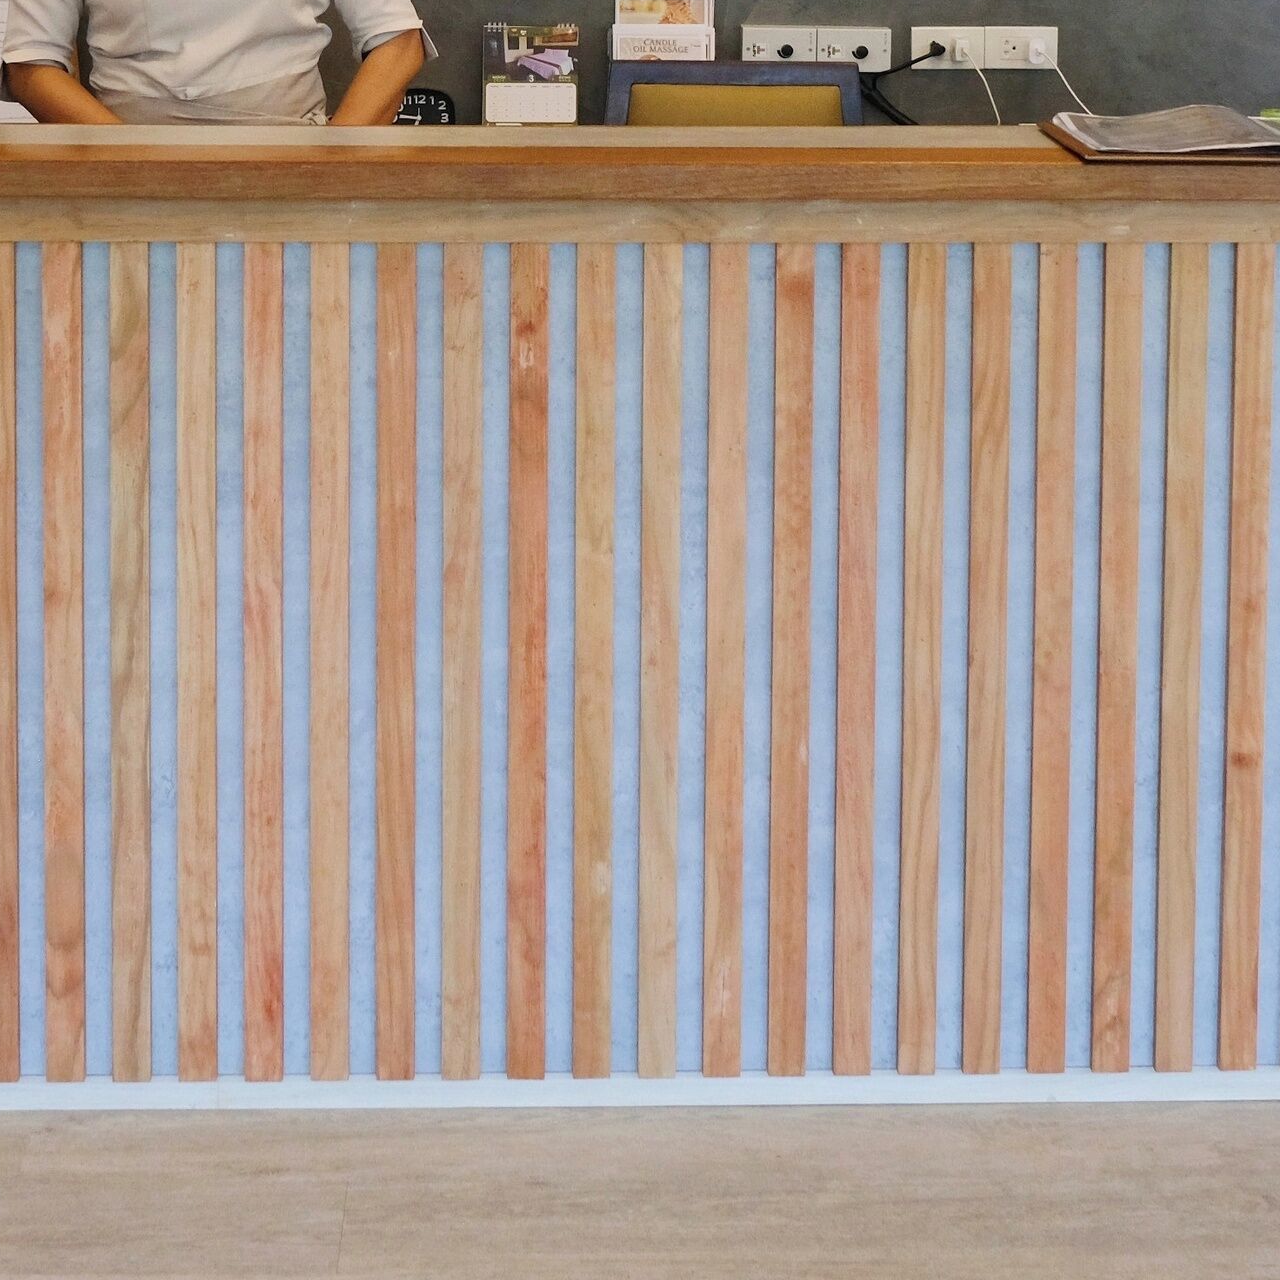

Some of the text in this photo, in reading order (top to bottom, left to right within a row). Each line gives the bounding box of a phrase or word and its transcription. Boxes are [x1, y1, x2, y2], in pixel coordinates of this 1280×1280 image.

[643, 38, 677, 47] CANDLE
[632, 45, 647, 53] OIL
[649, 45, 689, 54] MASSAGE
[528, 75, 535, 83] 3
[414, 94, 426, 104] 12
[430, 96, 435, 105] 1
[438, 100, 446, 110] 2
[440, 113, 449, 123] 3
